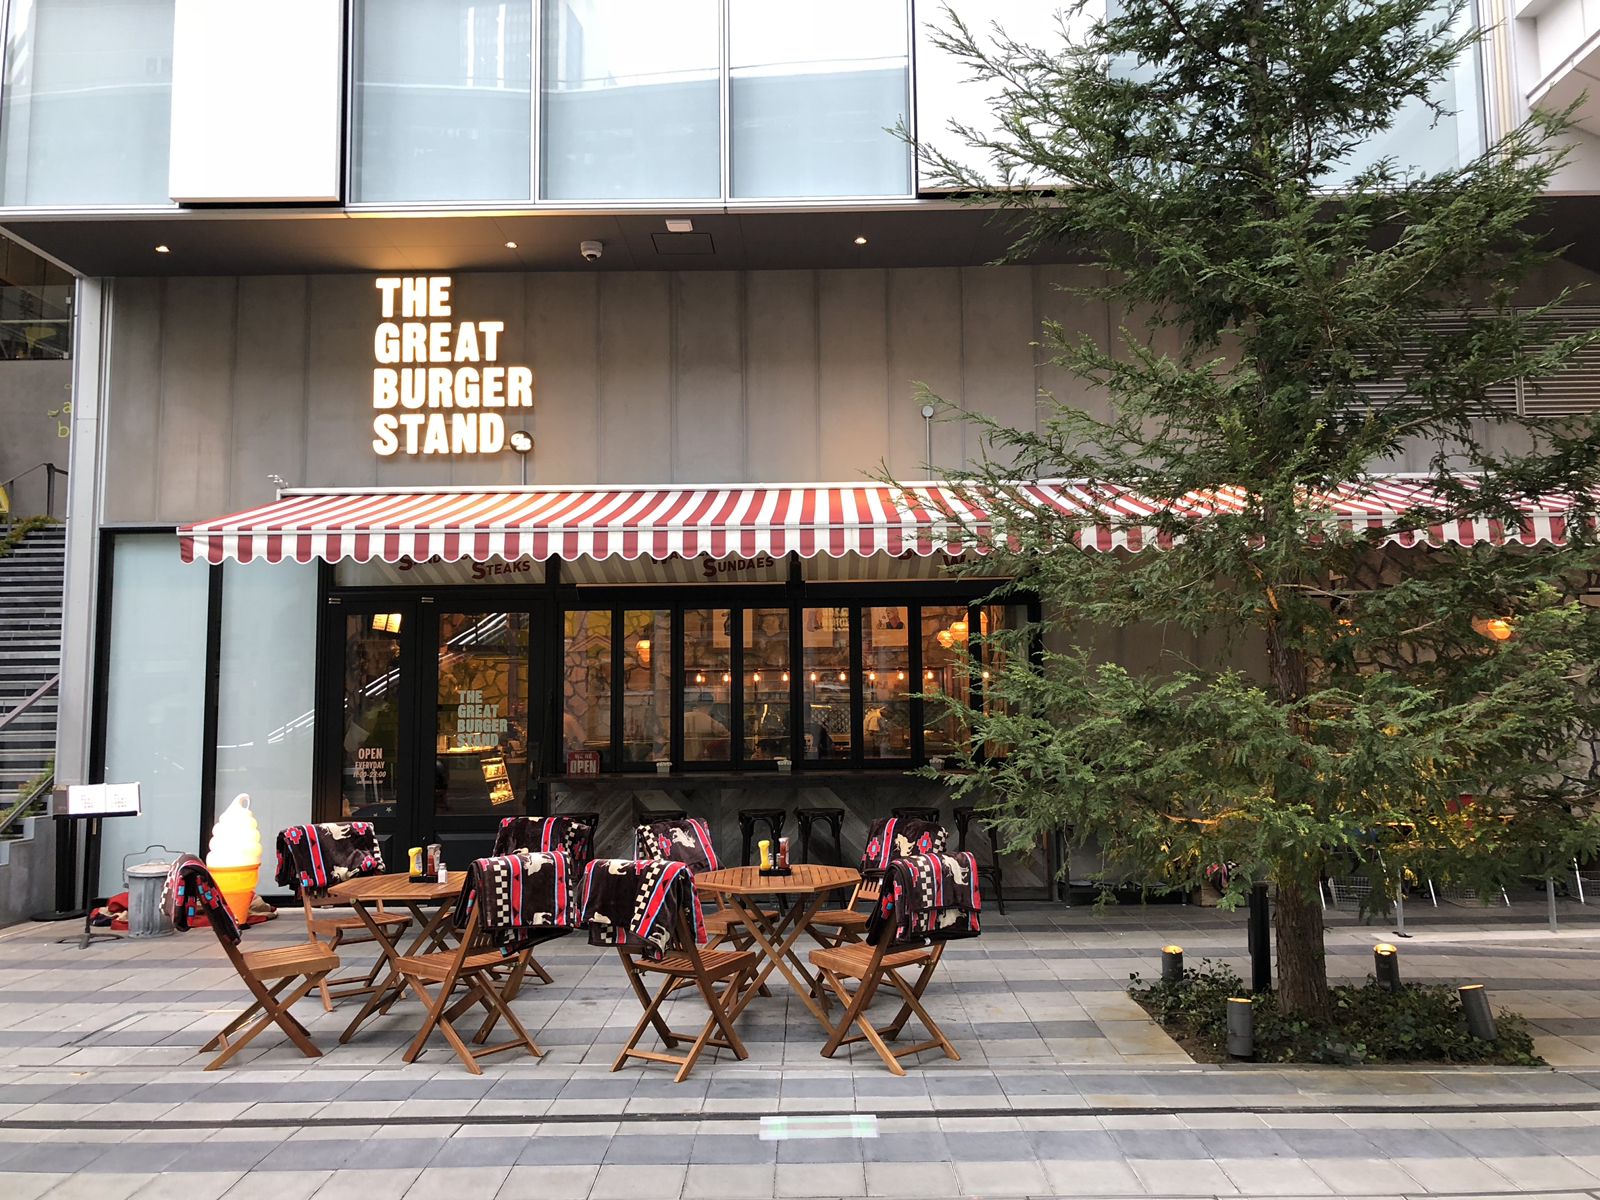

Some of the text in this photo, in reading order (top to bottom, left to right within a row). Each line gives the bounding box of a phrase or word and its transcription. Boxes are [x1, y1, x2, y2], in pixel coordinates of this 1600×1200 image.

[375, 276, 451, 318] THE
[374, 321, 504, 364] GREAT
[372, 366, 533, 409] BURGER
[472, 560, 531, 580] STEAKS
[703, 556, 774, 577] SUNDAES
[458, 690, 483, 703] THE
[457, 704, 499, 718] GREAT
[457, 718, 508, 732] BURGER
[457, 733, 499, 747] STAND
[358, 747, 383, 760] OPEN
[354, 761, 385, 769] EVERYDAY
[569, 759, 597, 773] OPEN
